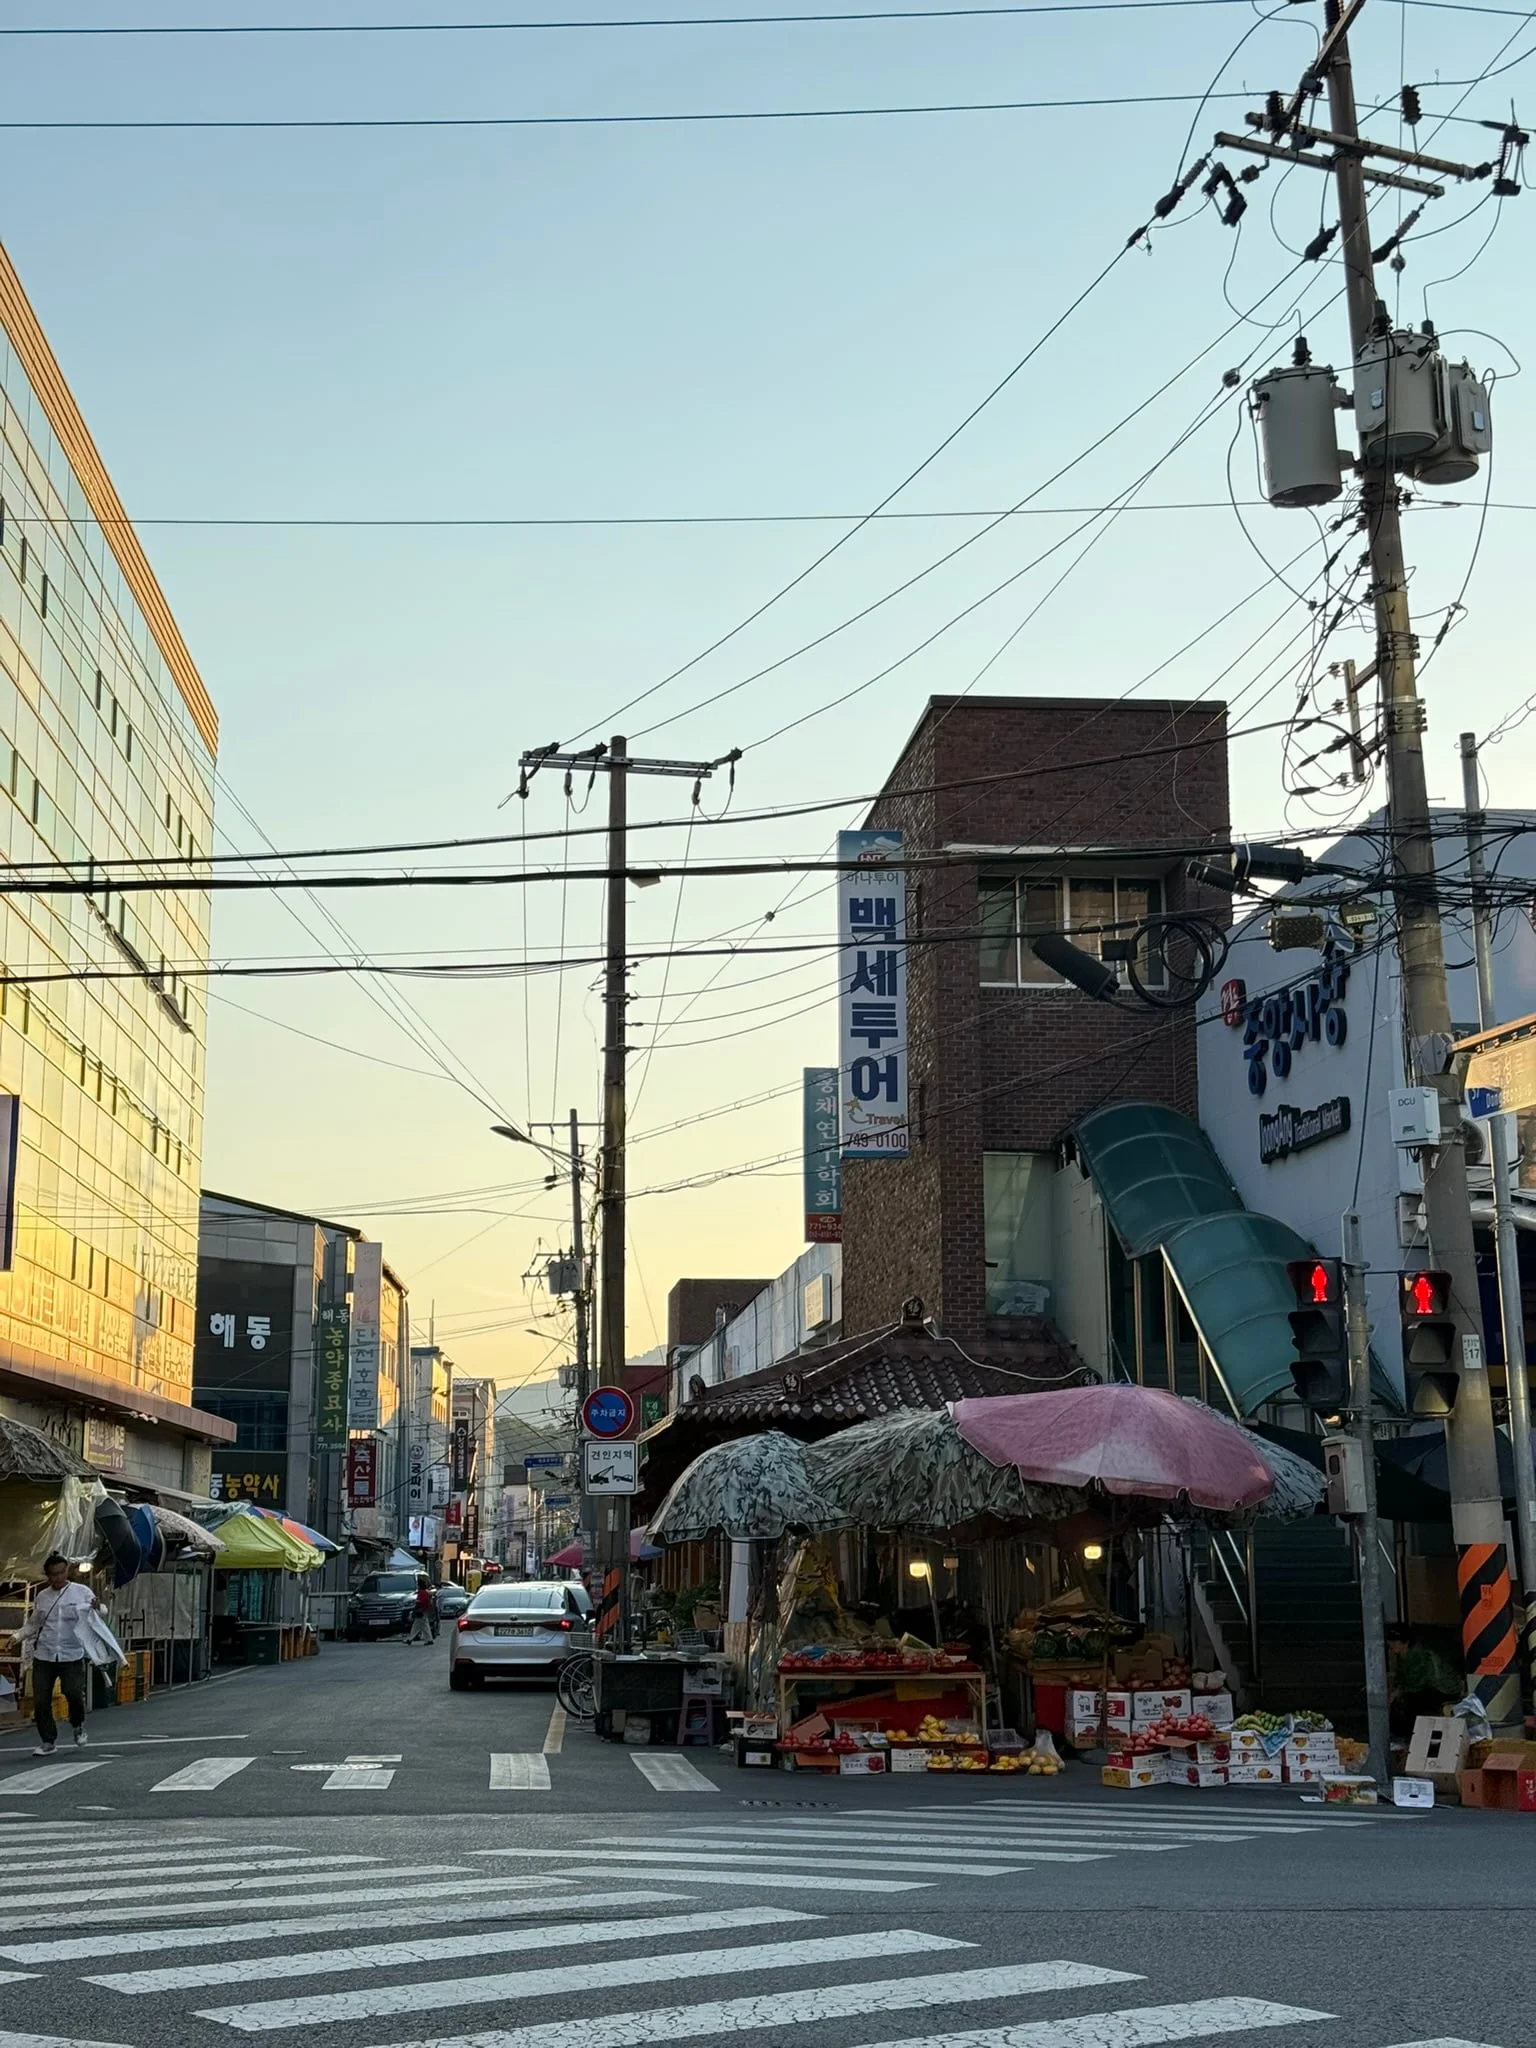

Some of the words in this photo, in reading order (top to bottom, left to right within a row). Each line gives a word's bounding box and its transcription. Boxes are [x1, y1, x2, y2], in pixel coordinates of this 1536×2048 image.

[847, 871, 899, 886] 하나투어
[849, 897, 899, 1103] 백세투어
[865, 1113, 907, 1125] Travel
[845, 1133, 907, 1148] 749-0100
[321, 1310, 350, 1325] 해동
[209, 1312, 272, 1351] 해동
[352, 1328, 377, 1408] 단전호흡
[322, 1327, 346, 1437] 농약종묘사
[590, 1408, 626, 1418] 주차금지
[591, 1450, 633, 1461] 견인지역
